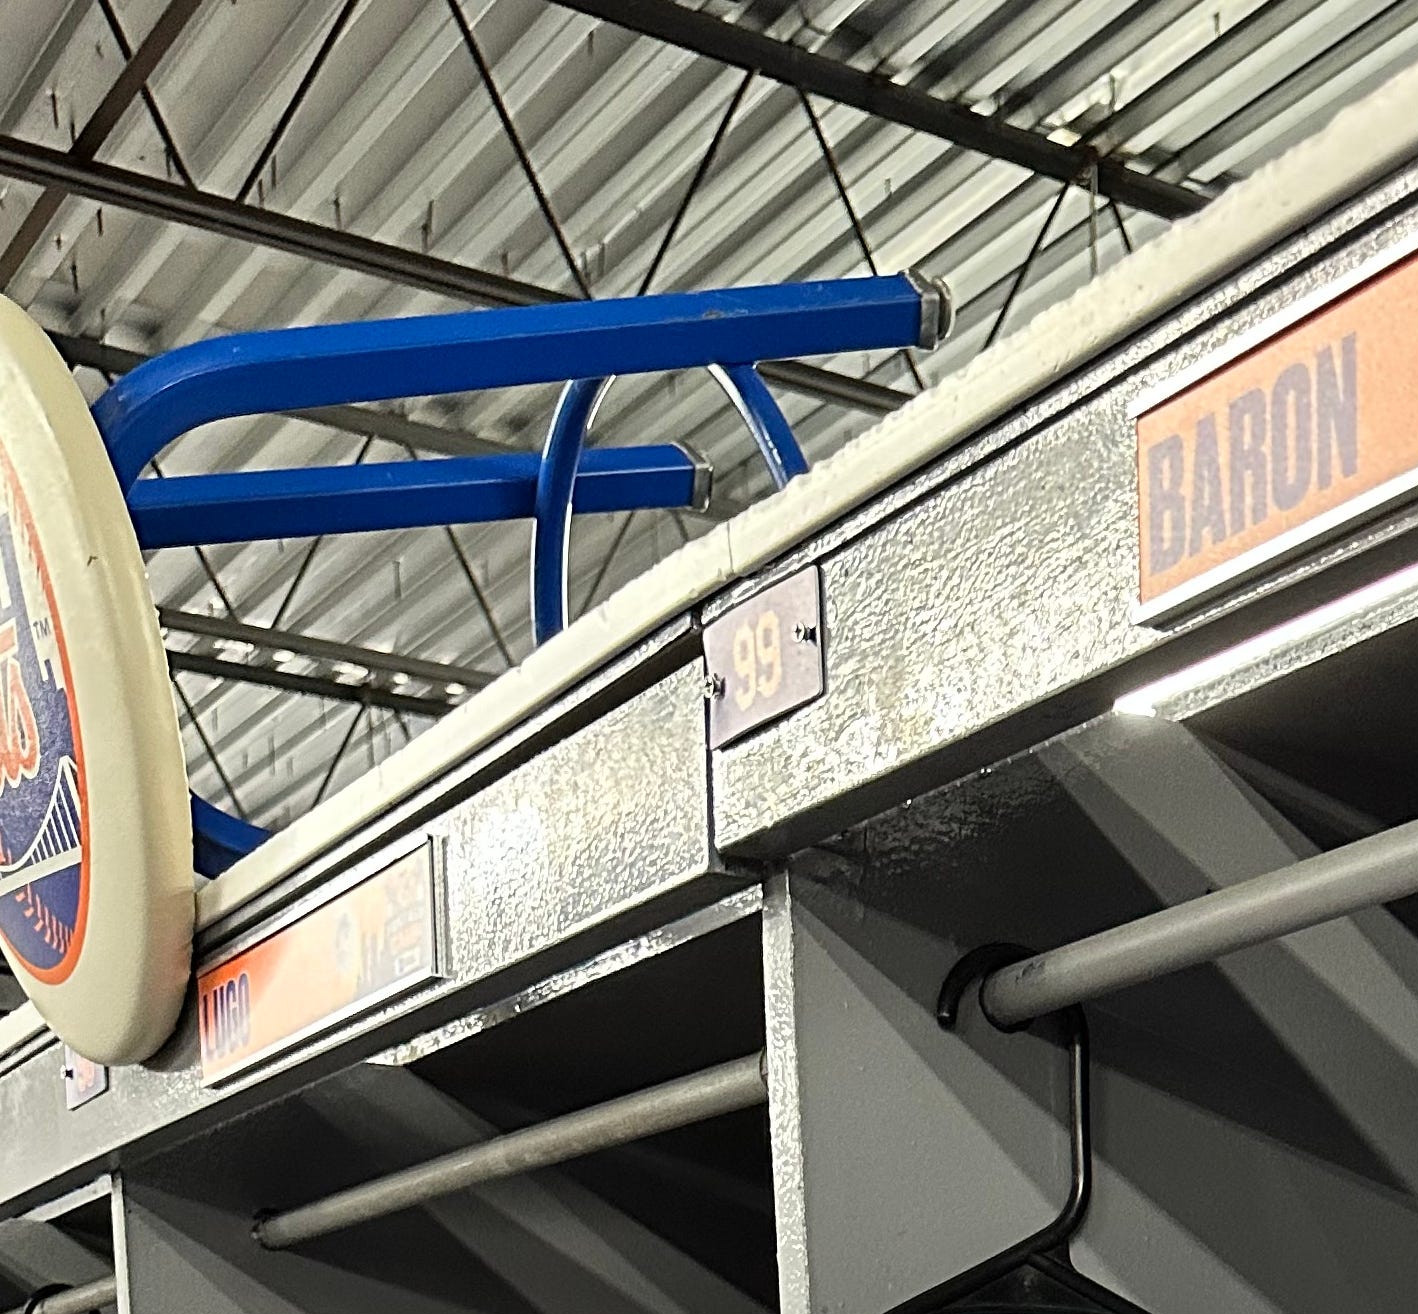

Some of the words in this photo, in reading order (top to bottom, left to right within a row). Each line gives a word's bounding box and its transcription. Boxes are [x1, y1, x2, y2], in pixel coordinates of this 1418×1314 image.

[1147, 331, 1358, 577] BARON
[32, 617, 51, 640] TM
[733, 610, 783, 712] 99
[202, 972, 251, 1058] LUGO
